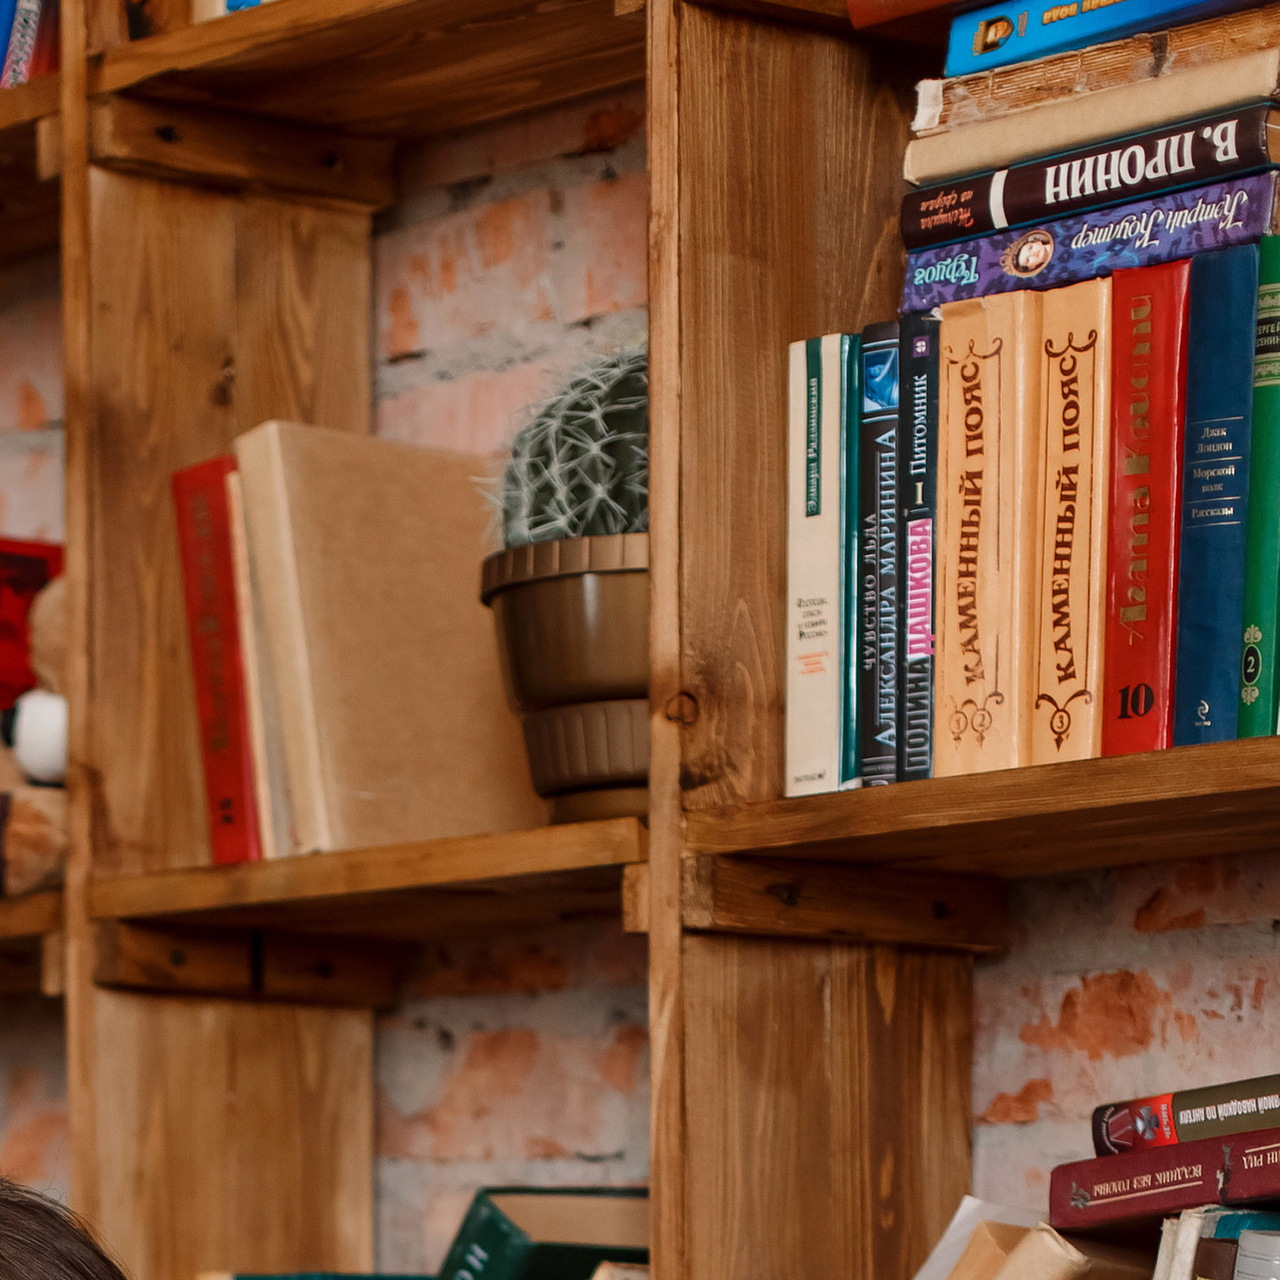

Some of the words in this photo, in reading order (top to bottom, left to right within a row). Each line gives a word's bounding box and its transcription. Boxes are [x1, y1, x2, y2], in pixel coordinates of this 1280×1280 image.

[1202, 119, 1239, 163] В.
[1044, 130, 1196, 204] ПРОНИН
[1070, 209, 1164, 249] Коултер
[1165, 190, 1248, 230] Кэтрин
[913, 253, 980, 286] Герцог
[960, 360, 985, 457] ПОЯС
[1062, 354, 1081, 453] ПОЯС
[910, 373, 928, 476] Питомник
[1201, 427, 1227, 439] Джек
[1196, 442, 1233, 454] Лондон
[1193, 464, 1235, 480] Морской
[879, 426, 897, 575] МАРИНИНА
[1191, 507, 1234, 518] Рассказы
[863, 512, 878, 555] ЛЬДА
[906, 518, 936, 656] ДАШКОВА
[958, 469, 985, 689] КАМЕННЫЙ
[1051, 464, 1079, 685] КАМЕННЫЙ
[864, 572, 878, 671] ЧУВСТВО
[874, 579, 897, 748] АЛЕКСАНДРА
[1245, 656, 1256, 673] 2
[905, 658, 932, 770] ПОЛИНА
[1056, 713, 1066, 729] 3
[1117, 683, 1154, 720] 10
[1179, 1107, 1206, 1126] АНГЕЛУ
[1205, 1104, 1218, 1121] ПО
[1217, 1098, 1257, 1121] НАВОДКОЙ
[1092, 1180, 1131, 1197] ГОЛОВЫ
[1133, 1174, 1152, 1189] БЕЗ
[1155, 1164, 1203, 1185] ВСАДНИК
